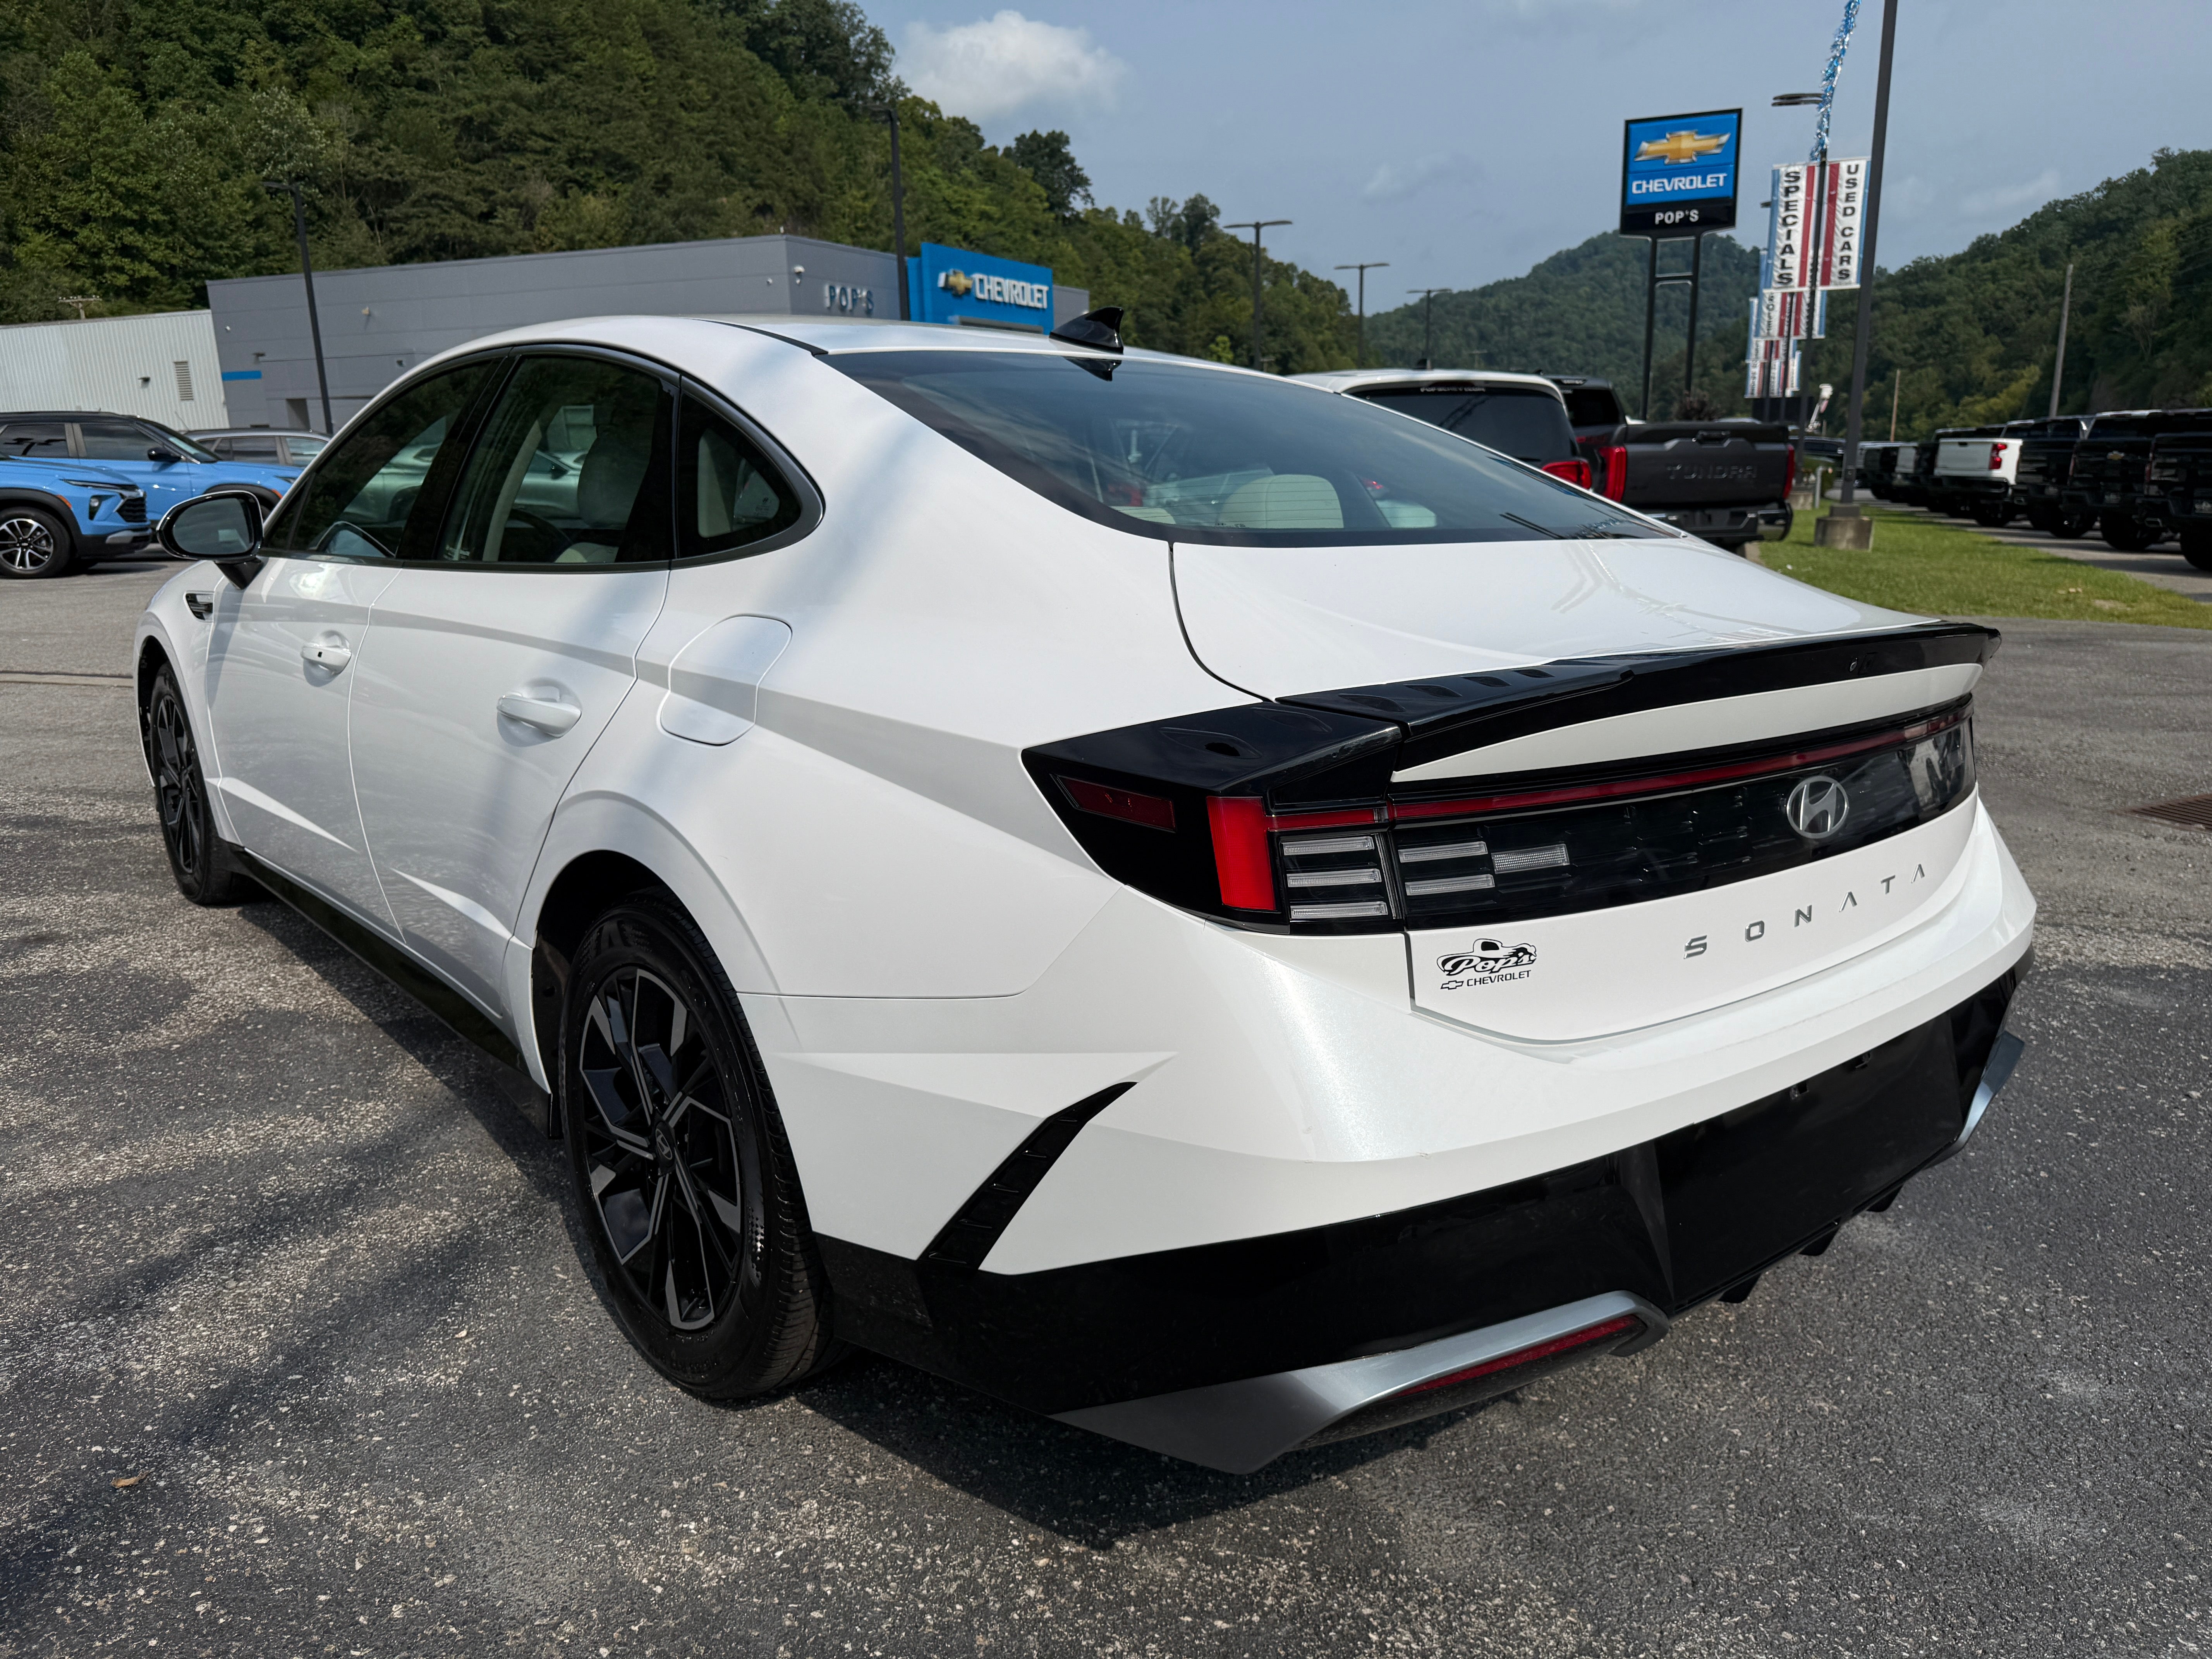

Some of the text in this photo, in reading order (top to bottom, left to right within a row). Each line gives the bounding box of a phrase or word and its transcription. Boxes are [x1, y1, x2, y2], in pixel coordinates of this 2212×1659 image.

[1632, 173, 1728, 194] CHEVROLET
[1654, 209, 1699, 225] POP'S
[1778, 171, 1801, 285] SPECIALS
[1838, 164, 1859, 279] USED CARS
[825, 283, 874, 311] POP'S
[972, 273, 1049, 309] CHEVROLET
[1667, 464, 1757, 479] TUNDRA
[1683, 864, 1925, 959] SONATA
[1467, 970, 1531, 986] CHEVROLET
